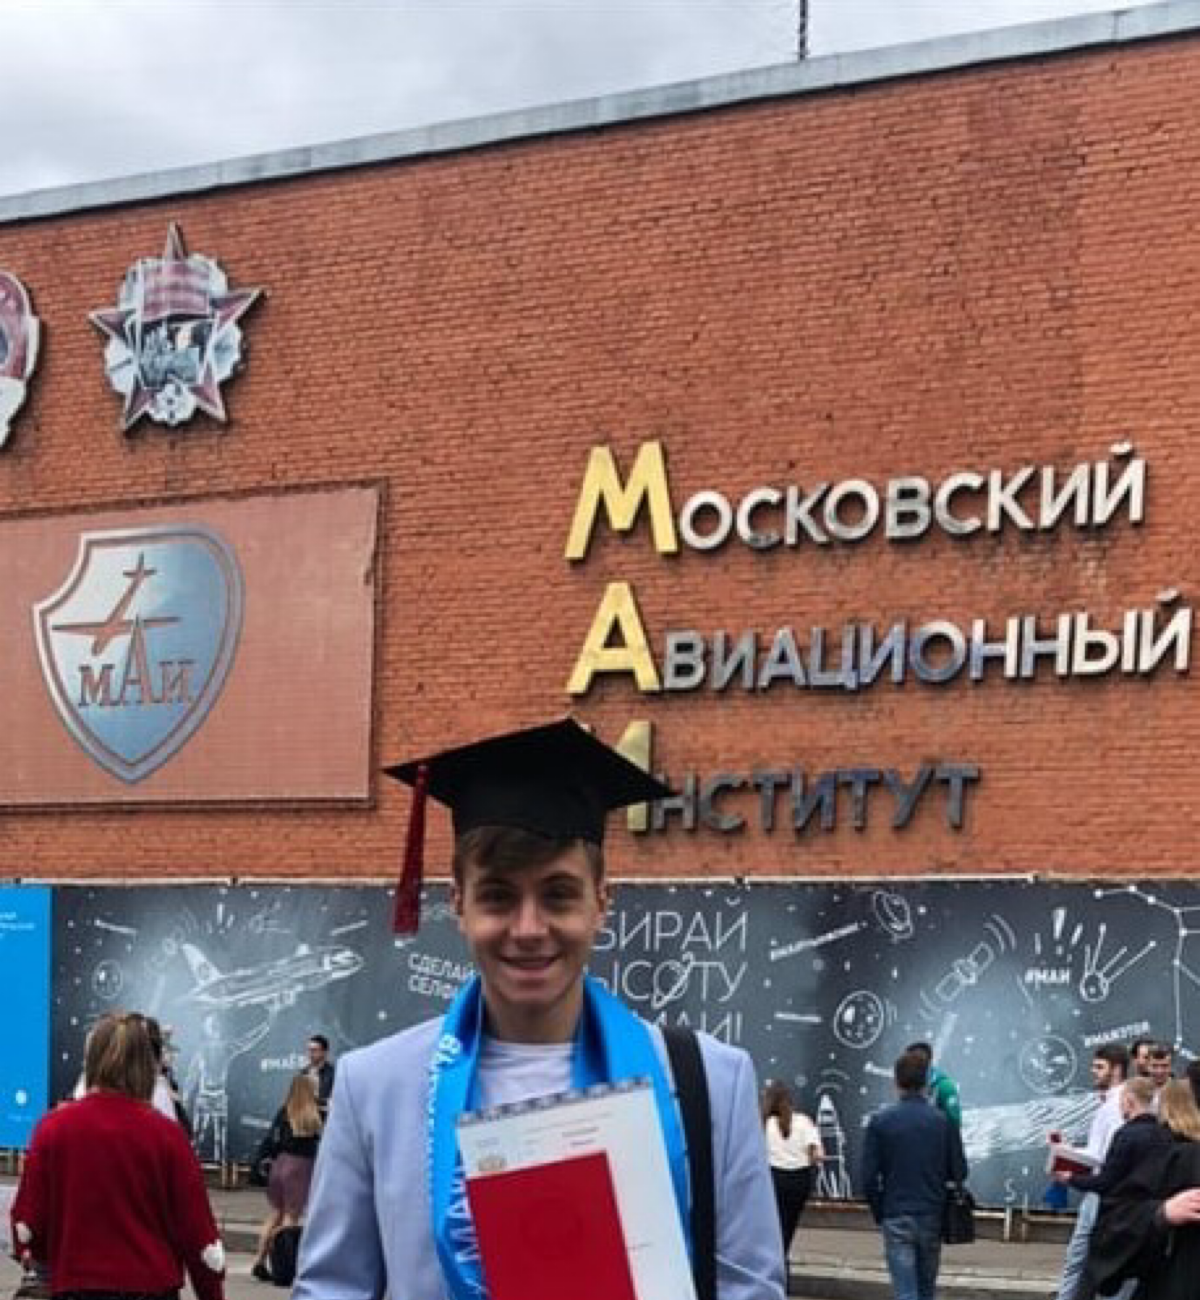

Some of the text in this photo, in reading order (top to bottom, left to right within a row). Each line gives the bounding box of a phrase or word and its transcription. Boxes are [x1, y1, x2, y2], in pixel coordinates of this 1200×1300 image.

[564, 441, 1148, 562] МОСКОВСКИЙ
[78, 613, 196, 712] МАИ
[566, 580, 1193, 695] АВИАЦИОННЫЙ
